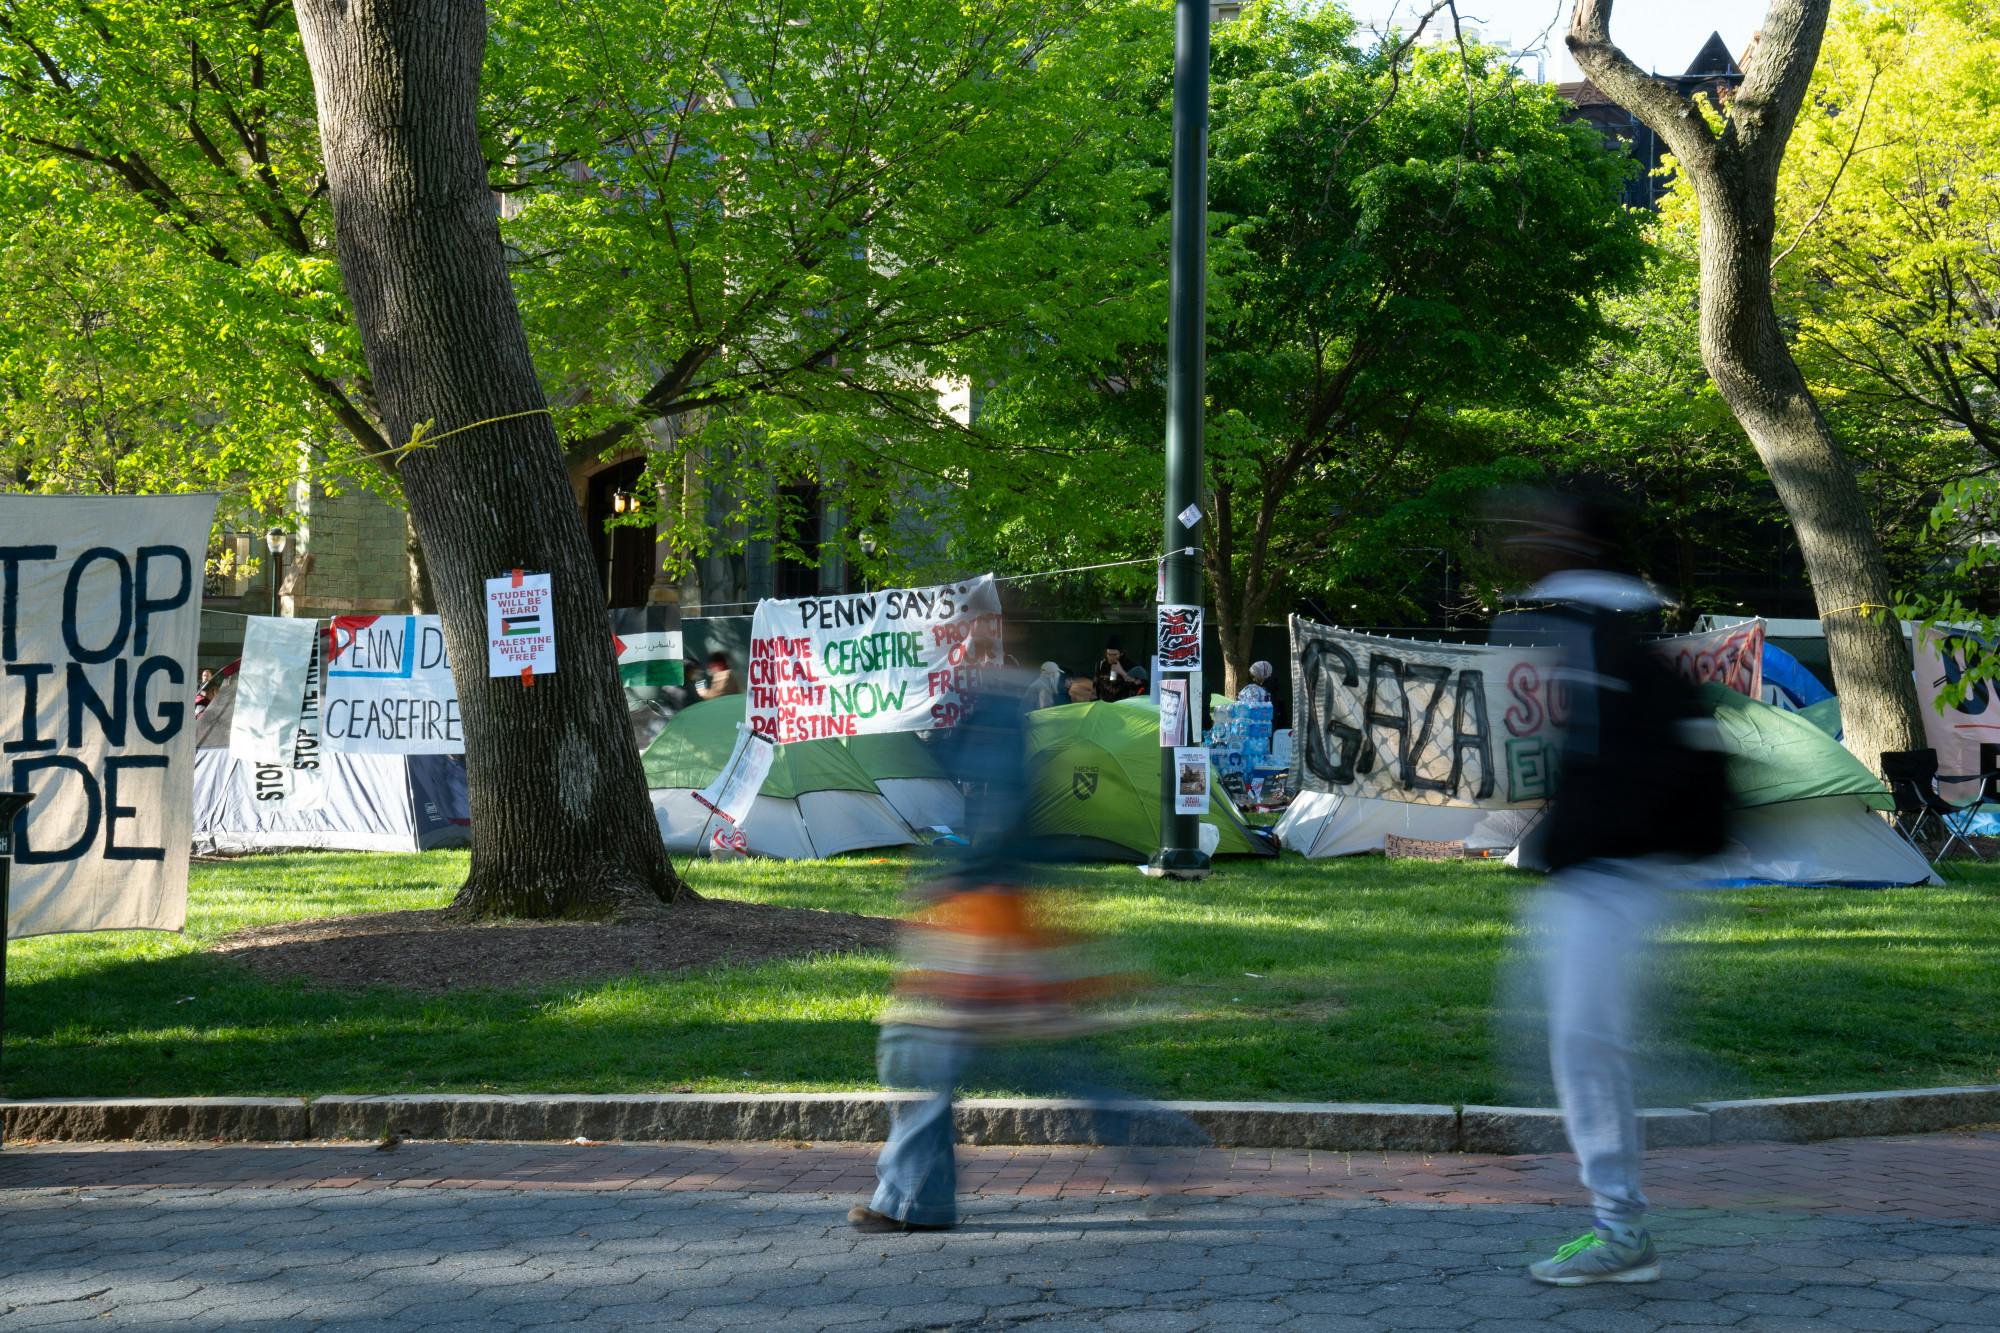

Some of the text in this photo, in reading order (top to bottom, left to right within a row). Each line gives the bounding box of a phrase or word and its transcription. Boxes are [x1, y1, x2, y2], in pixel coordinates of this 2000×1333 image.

[490, 589, 548, 600] STUDENTS
[498, 597, 542, 607] WILL BE
[798, 585, 969, 629] PENN SAYS:
[502, 606, 538, 615] HEARD
[335, 627, 403, 669] PENN
[492, 636, 552, 647] PALESTINE
[500, 646, 527, 654] WILL
[824, 630, 928, 676] CEASEFIRE
[509, 653, 536, 662] FREE
[3, 655, 185, 753] ING
[751, 684, 826, 708] THOUGHT
[829, 680, 908, 718] NOW
[326, 699, 462, 742] CEASEFIRE
[778, 706, 796, 720] ON
[1301, 638, 1494, 800] GAZA
[751, 714, 857, 743] PALESTINE
[12, 755, 168, 865] DE
